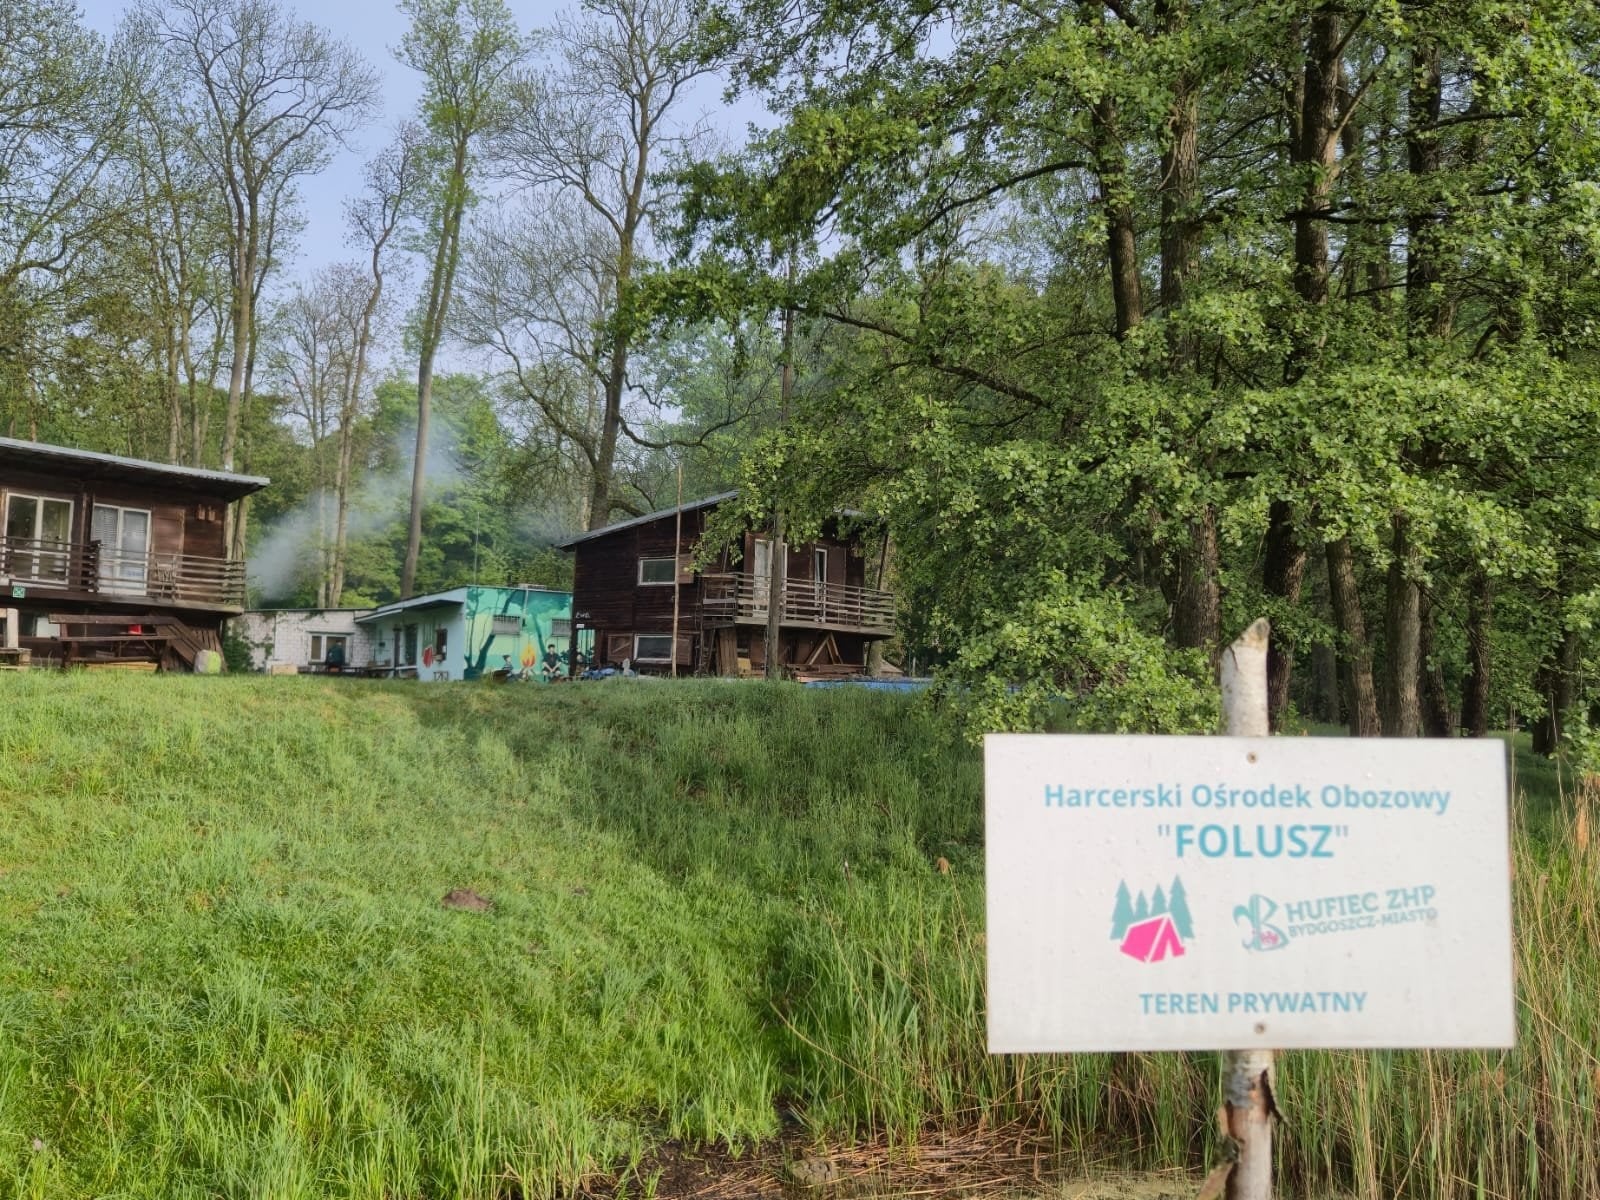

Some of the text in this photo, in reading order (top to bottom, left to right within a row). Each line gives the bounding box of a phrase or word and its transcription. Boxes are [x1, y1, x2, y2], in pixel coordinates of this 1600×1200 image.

[1044, 783, 1451, 816] Harcerski Ośrodek Obozowy
[1157, 824, 1349, 859] "FOLUSZ"
[1284, 884, 1436, 923] HUFIEC ZHP
[1287, 907, 1439, 938] BYDGOSZCZ-MIASTO
[1139, 992, 1368, 1014] TEREN PRYWATNY
